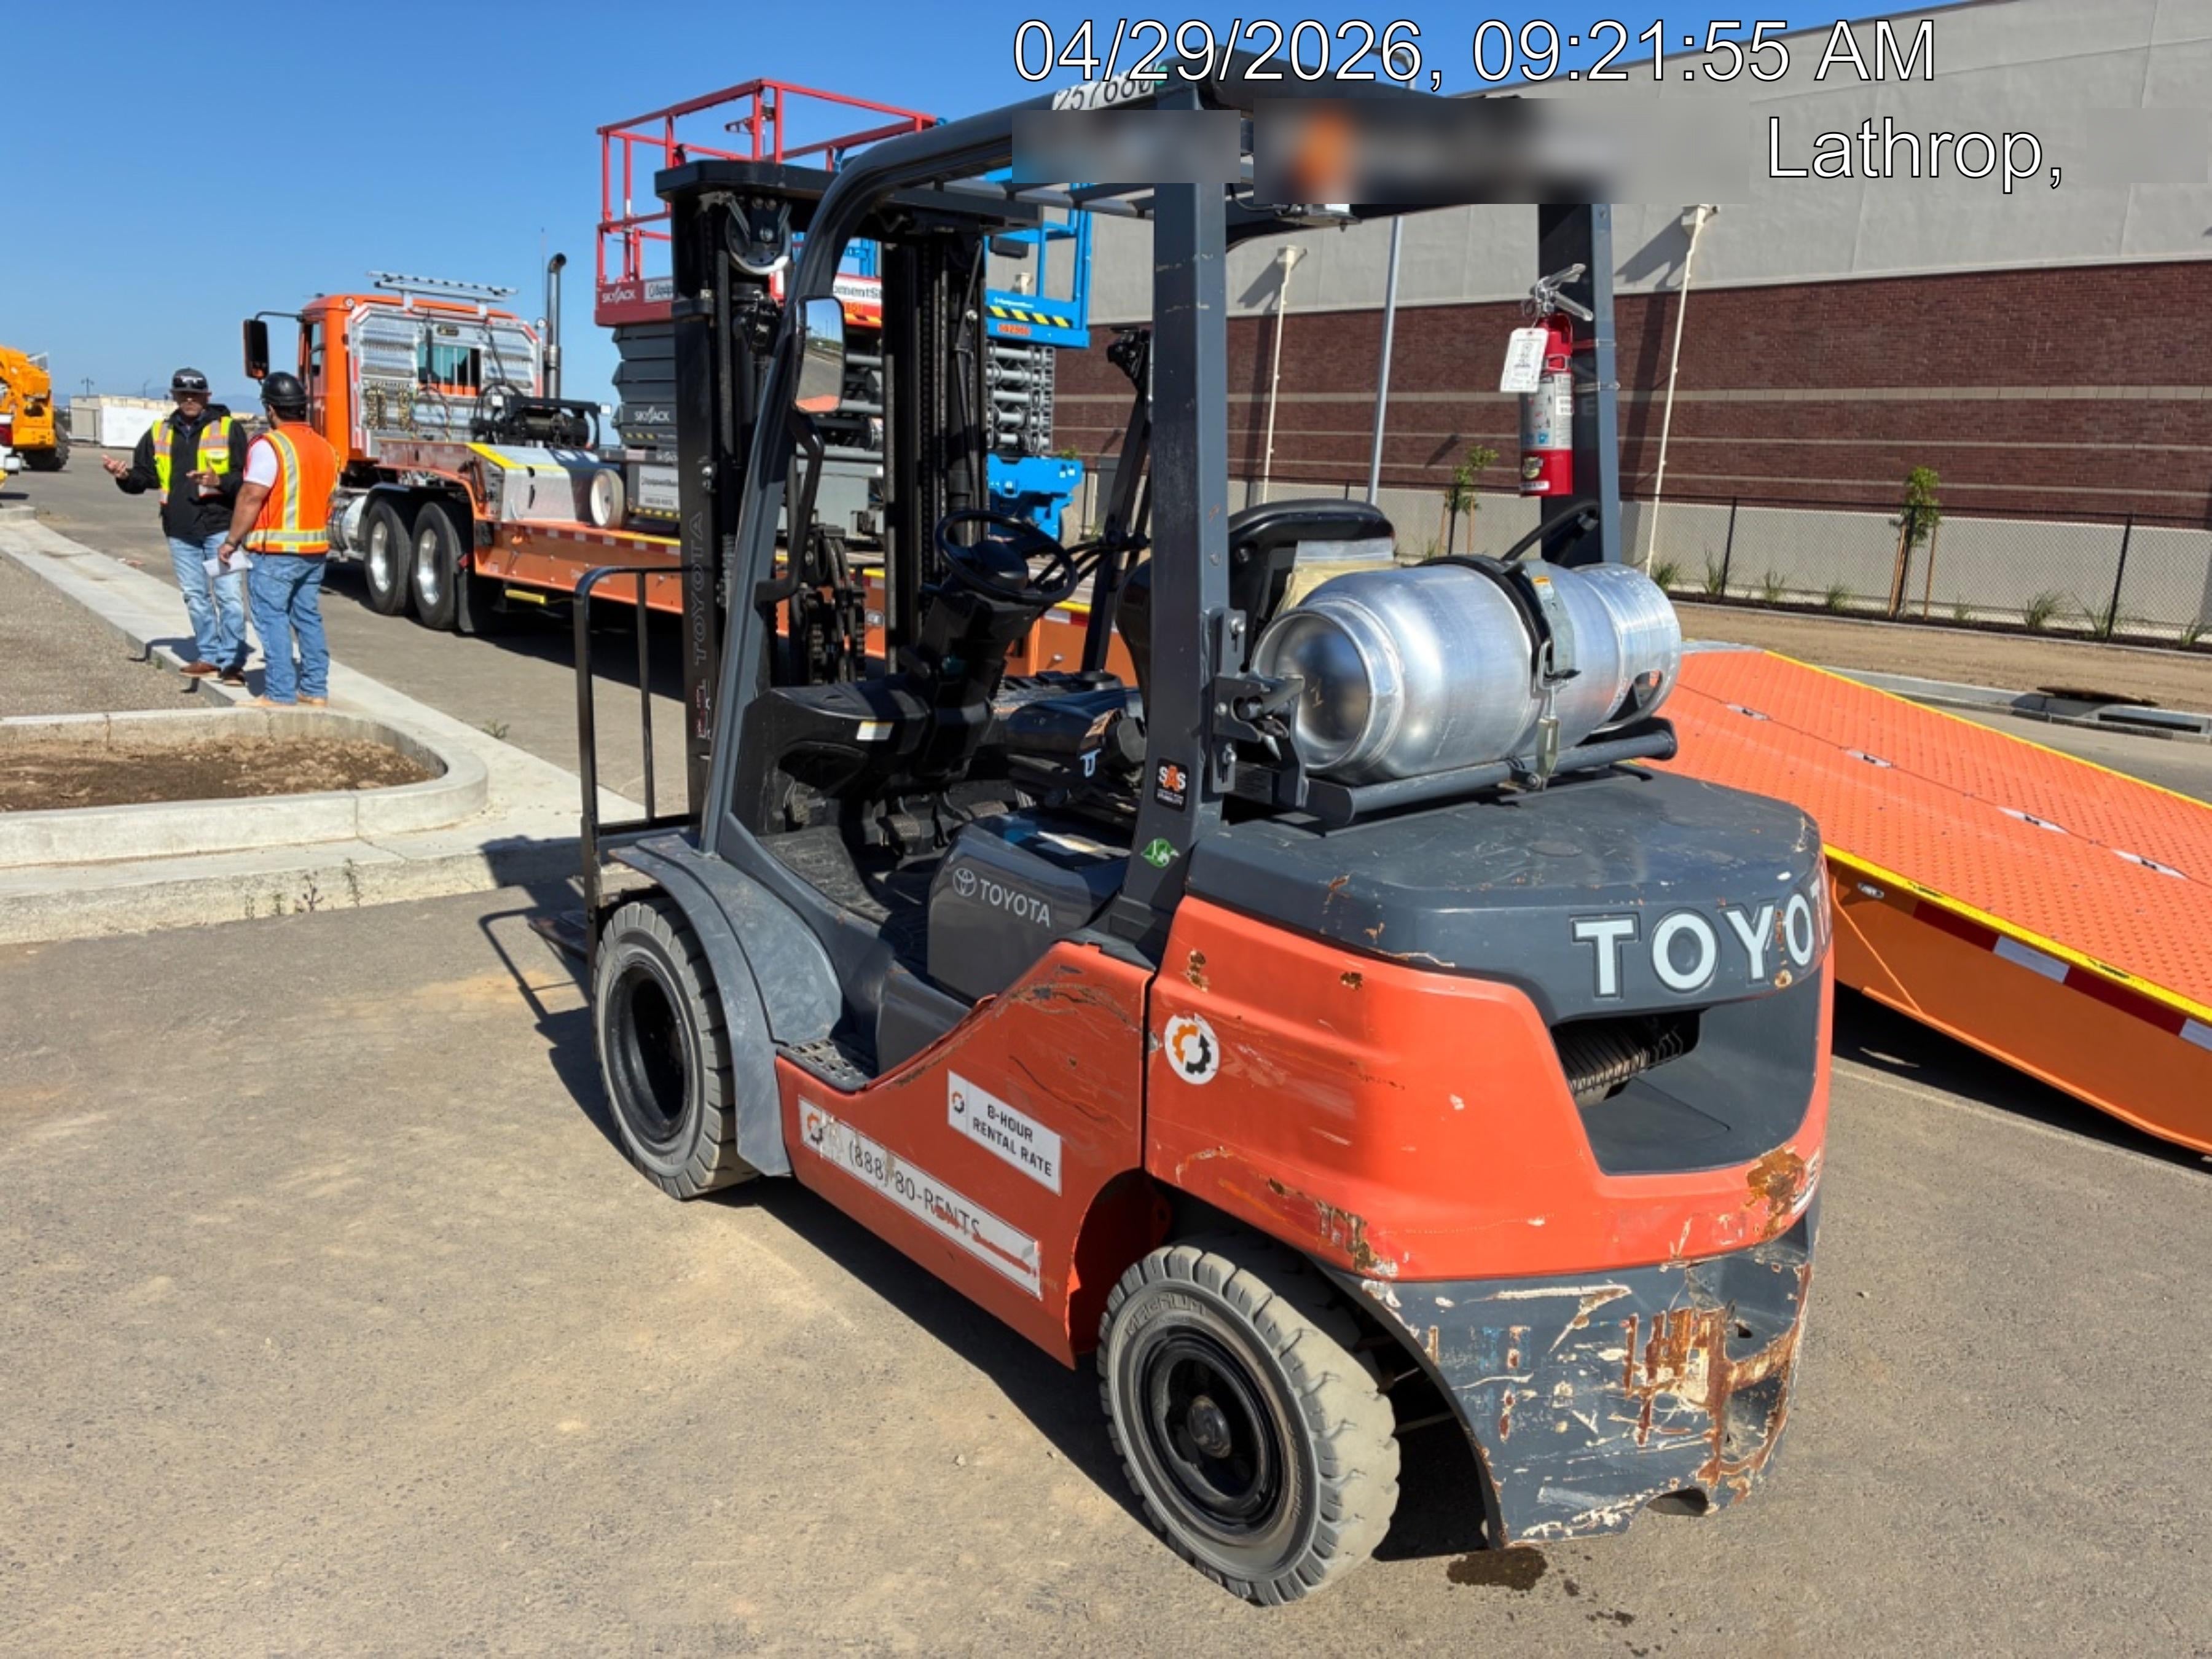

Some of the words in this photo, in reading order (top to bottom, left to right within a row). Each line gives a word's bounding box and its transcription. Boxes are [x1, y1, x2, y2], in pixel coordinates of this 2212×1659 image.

[689, 511, 707, 665] TOYOTA
[980, 878, 1050, 928] TOYOTA
[973, 1117, 1016, 1155] RENTAL
[1021, 1146, 1052, 1177] RATE
